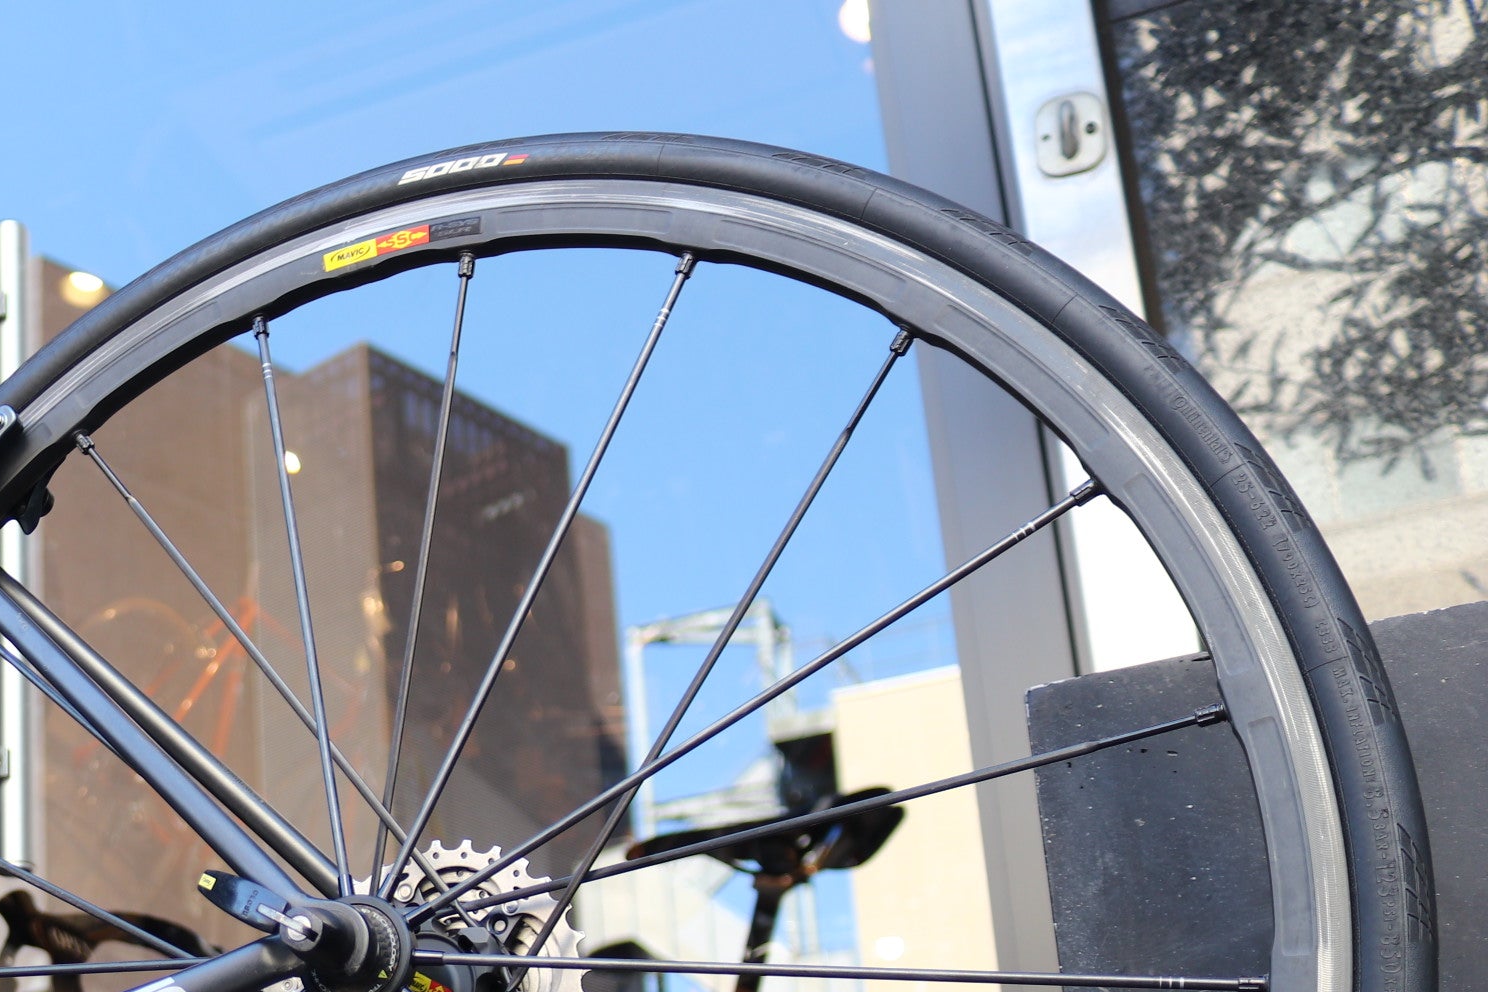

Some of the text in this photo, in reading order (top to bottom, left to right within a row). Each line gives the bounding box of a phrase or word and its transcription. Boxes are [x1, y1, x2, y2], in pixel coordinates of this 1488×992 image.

[397, 152, 508, 186] 5000
[337, 246, 365, 261] MAVIC
[1232, 472, 1278, 531] 25-622
